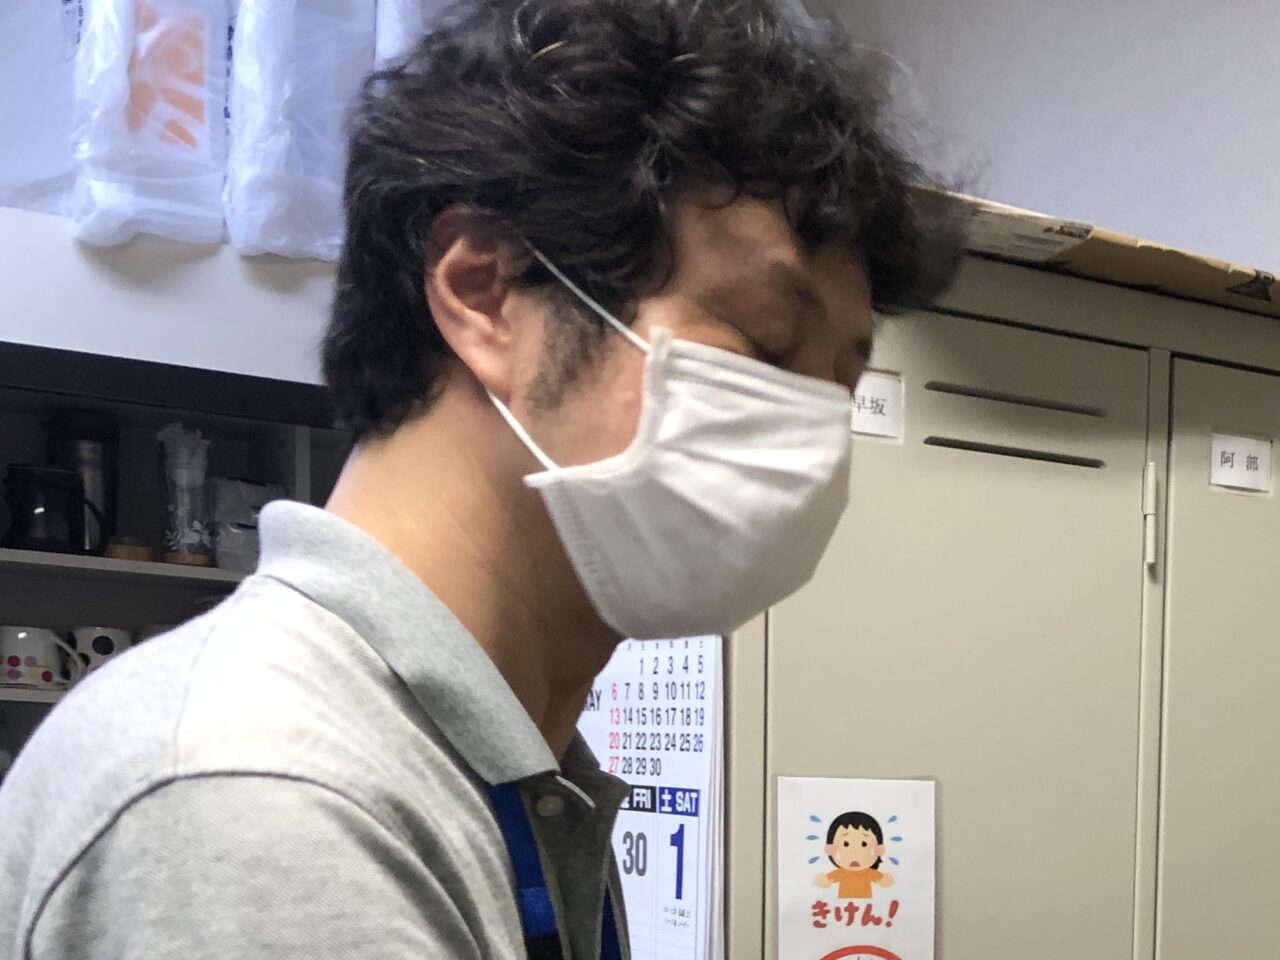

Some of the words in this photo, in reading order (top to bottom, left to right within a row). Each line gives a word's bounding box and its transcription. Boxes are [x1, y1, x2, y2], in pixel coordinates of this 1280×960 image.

[639, 657, 644, 675] 1
[652, 657, 659, 675] 2
[667, 656, 674, 674] 3
[682, 655, 689, 673] 4
[697, 655, 704, 673] 5
[611, 683, 618, 701] 6
[624, 682, 631, 700] 7
[638, 682, 644, 700] 8
[652, 682, 659, 700] 9
[665, 682, 677, 700] 10
[680, 681, 691, 699] 11
[695, 681, 705, 699] 12
[610, 708, 620, 725] 13
[622, 707, 633, 724] 14
[636, 708, 647, 725] 15
[650, 708, 661, 725] 16
[665, 708, 677, 725] 17
[680, 708, 691, 725] 18
[694, 708, 704, 725] 19
[608, 732, 620, 749] 20
[622, 733, 633, 750] 21
[635, 733, 647, 750] 22
[650, 733, 661, 750] 23
[664, 733, 676, 750] 24
[679, 734, 691, 751] 25
[693, 735, 704, 752] 26
[608, 756, 620, 774] 27
[622, 756, 633, 774] 28
[635, 757, 647, 775] 29
[650, 758, 662, 776] 30
[633, 788, 652, 809] FRI
[661, 789, 672, 812] 土
[675, 791, 698, 813] SAT
[622, 831, 647, 877] 30
[670, 823, 685, 900] 1
[811, 900, 899, 928] きけん!
